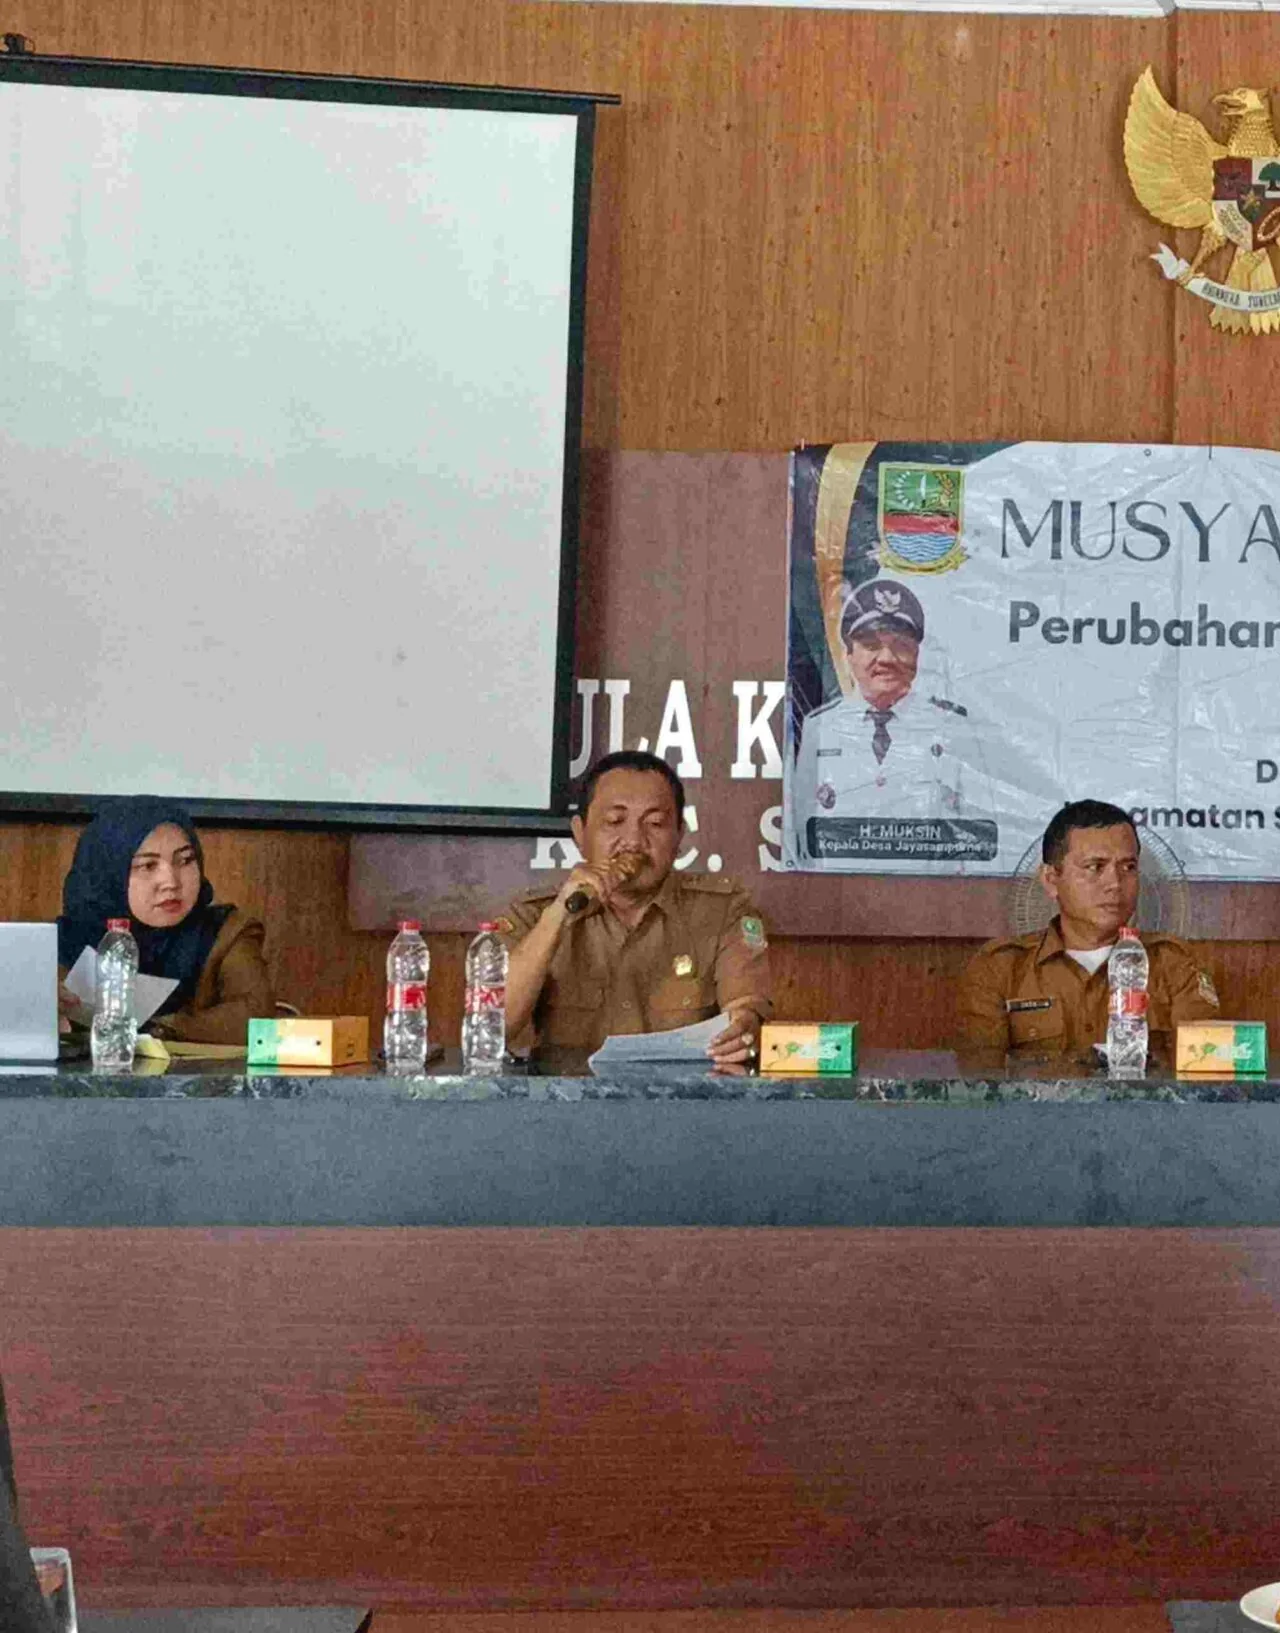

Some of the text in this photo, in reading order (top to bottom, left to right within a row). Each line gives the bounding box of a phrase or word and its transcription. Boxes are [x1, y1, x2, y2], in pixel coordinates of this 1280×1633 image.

[1129, 802, 1266, 831] amatan
[880, 825, 942, 840] MUKSIN
[818, 839, 860, 853] Kepala
[861, 840, 892, 851] Desa
